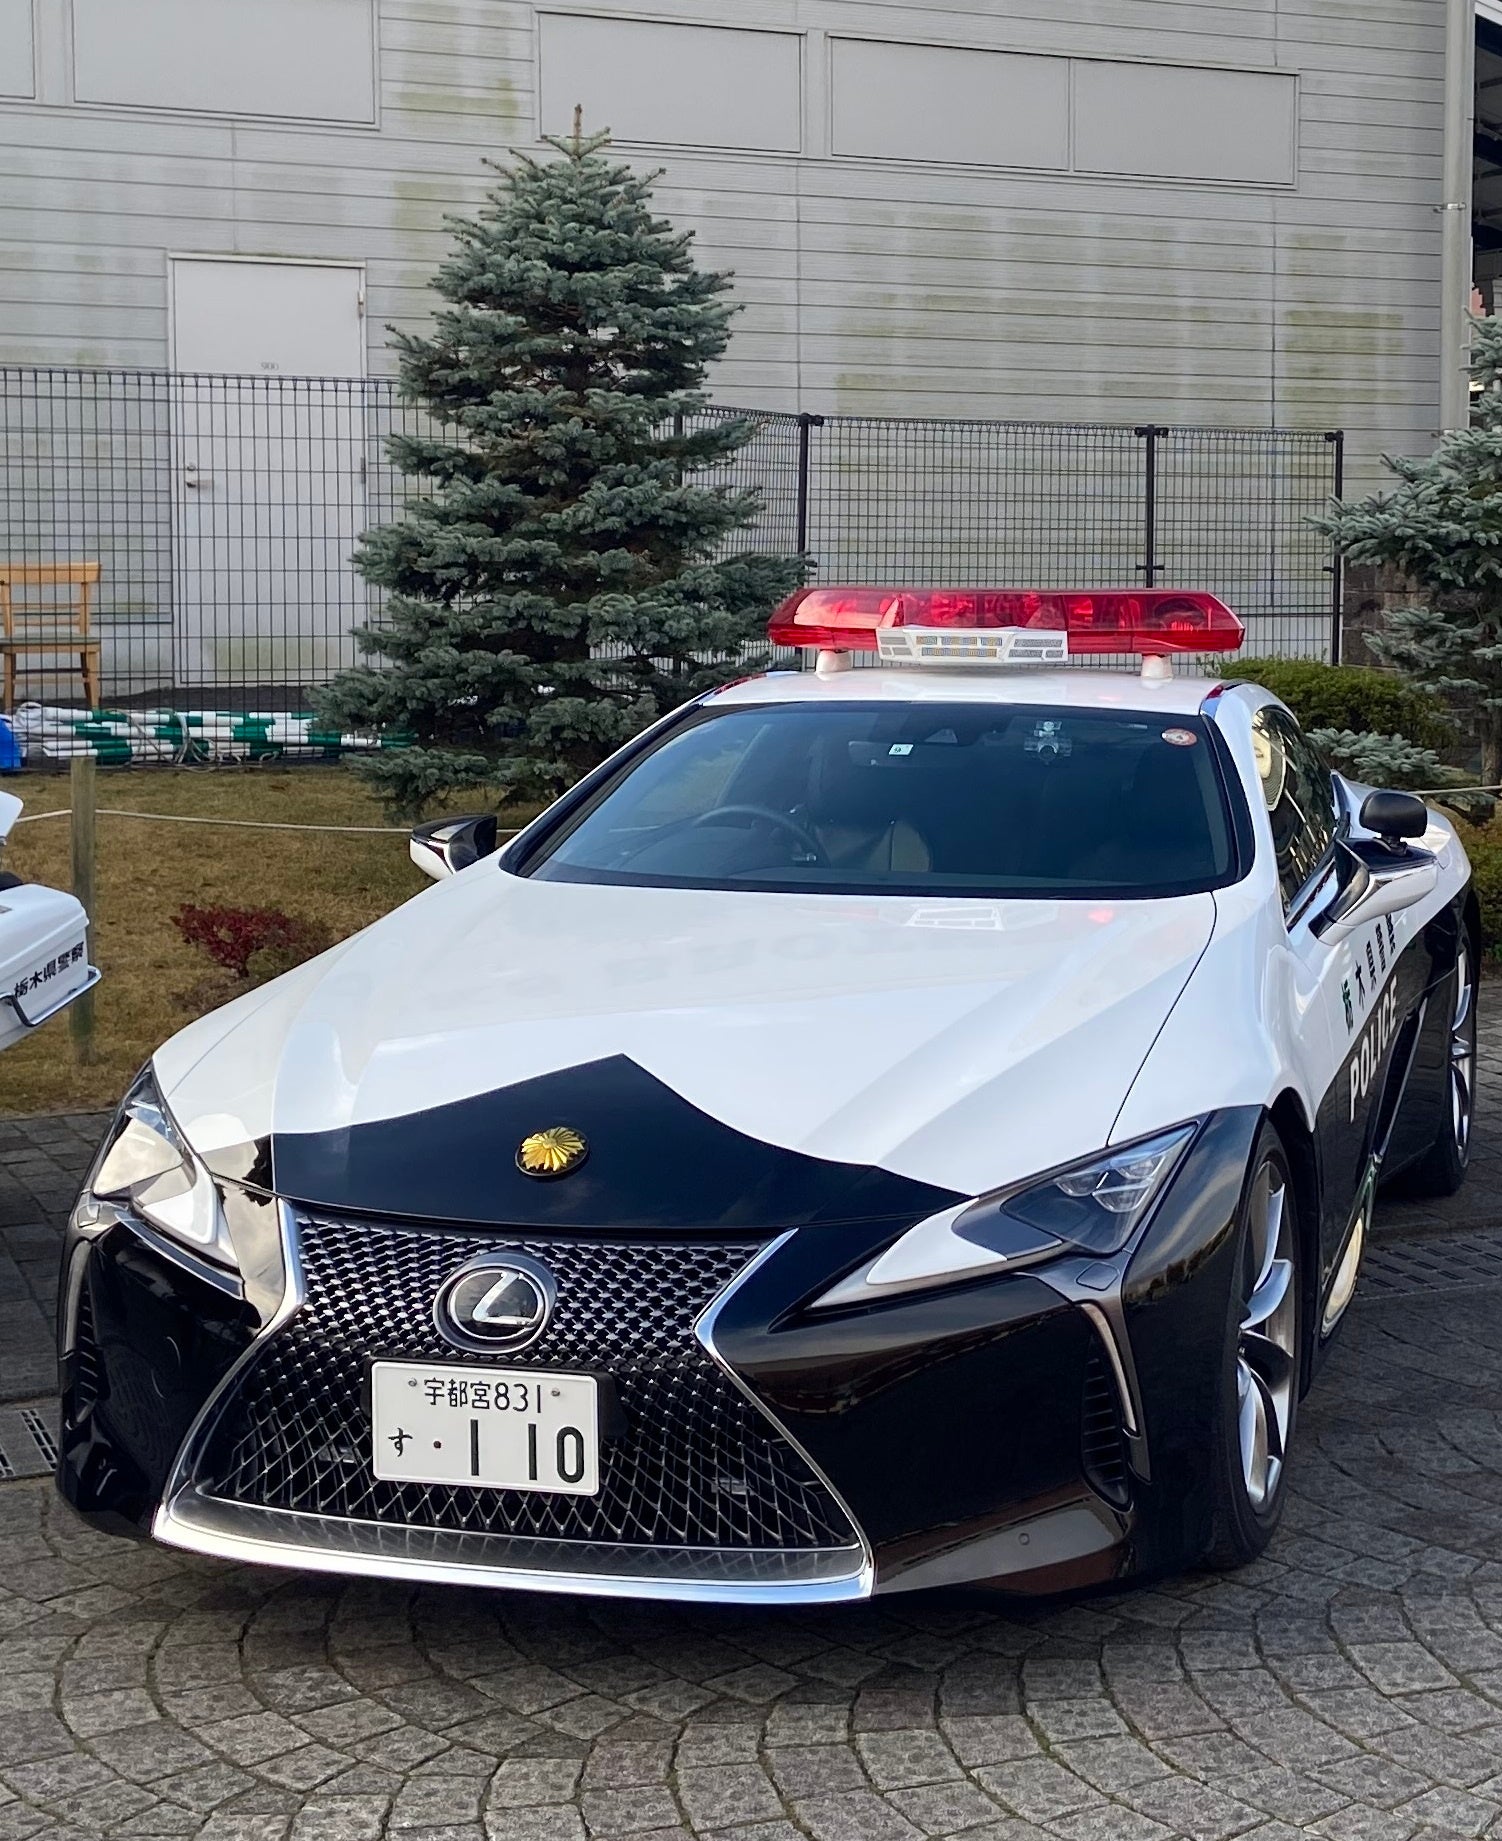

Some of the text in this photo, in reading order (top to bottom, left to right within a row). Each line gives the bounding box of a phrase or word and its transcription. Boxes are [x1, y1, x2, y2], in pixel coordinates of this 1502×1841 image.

[14, 941, 84, 998] 栃木県警察
[1350, 974, 1398, 1124] POLICE
